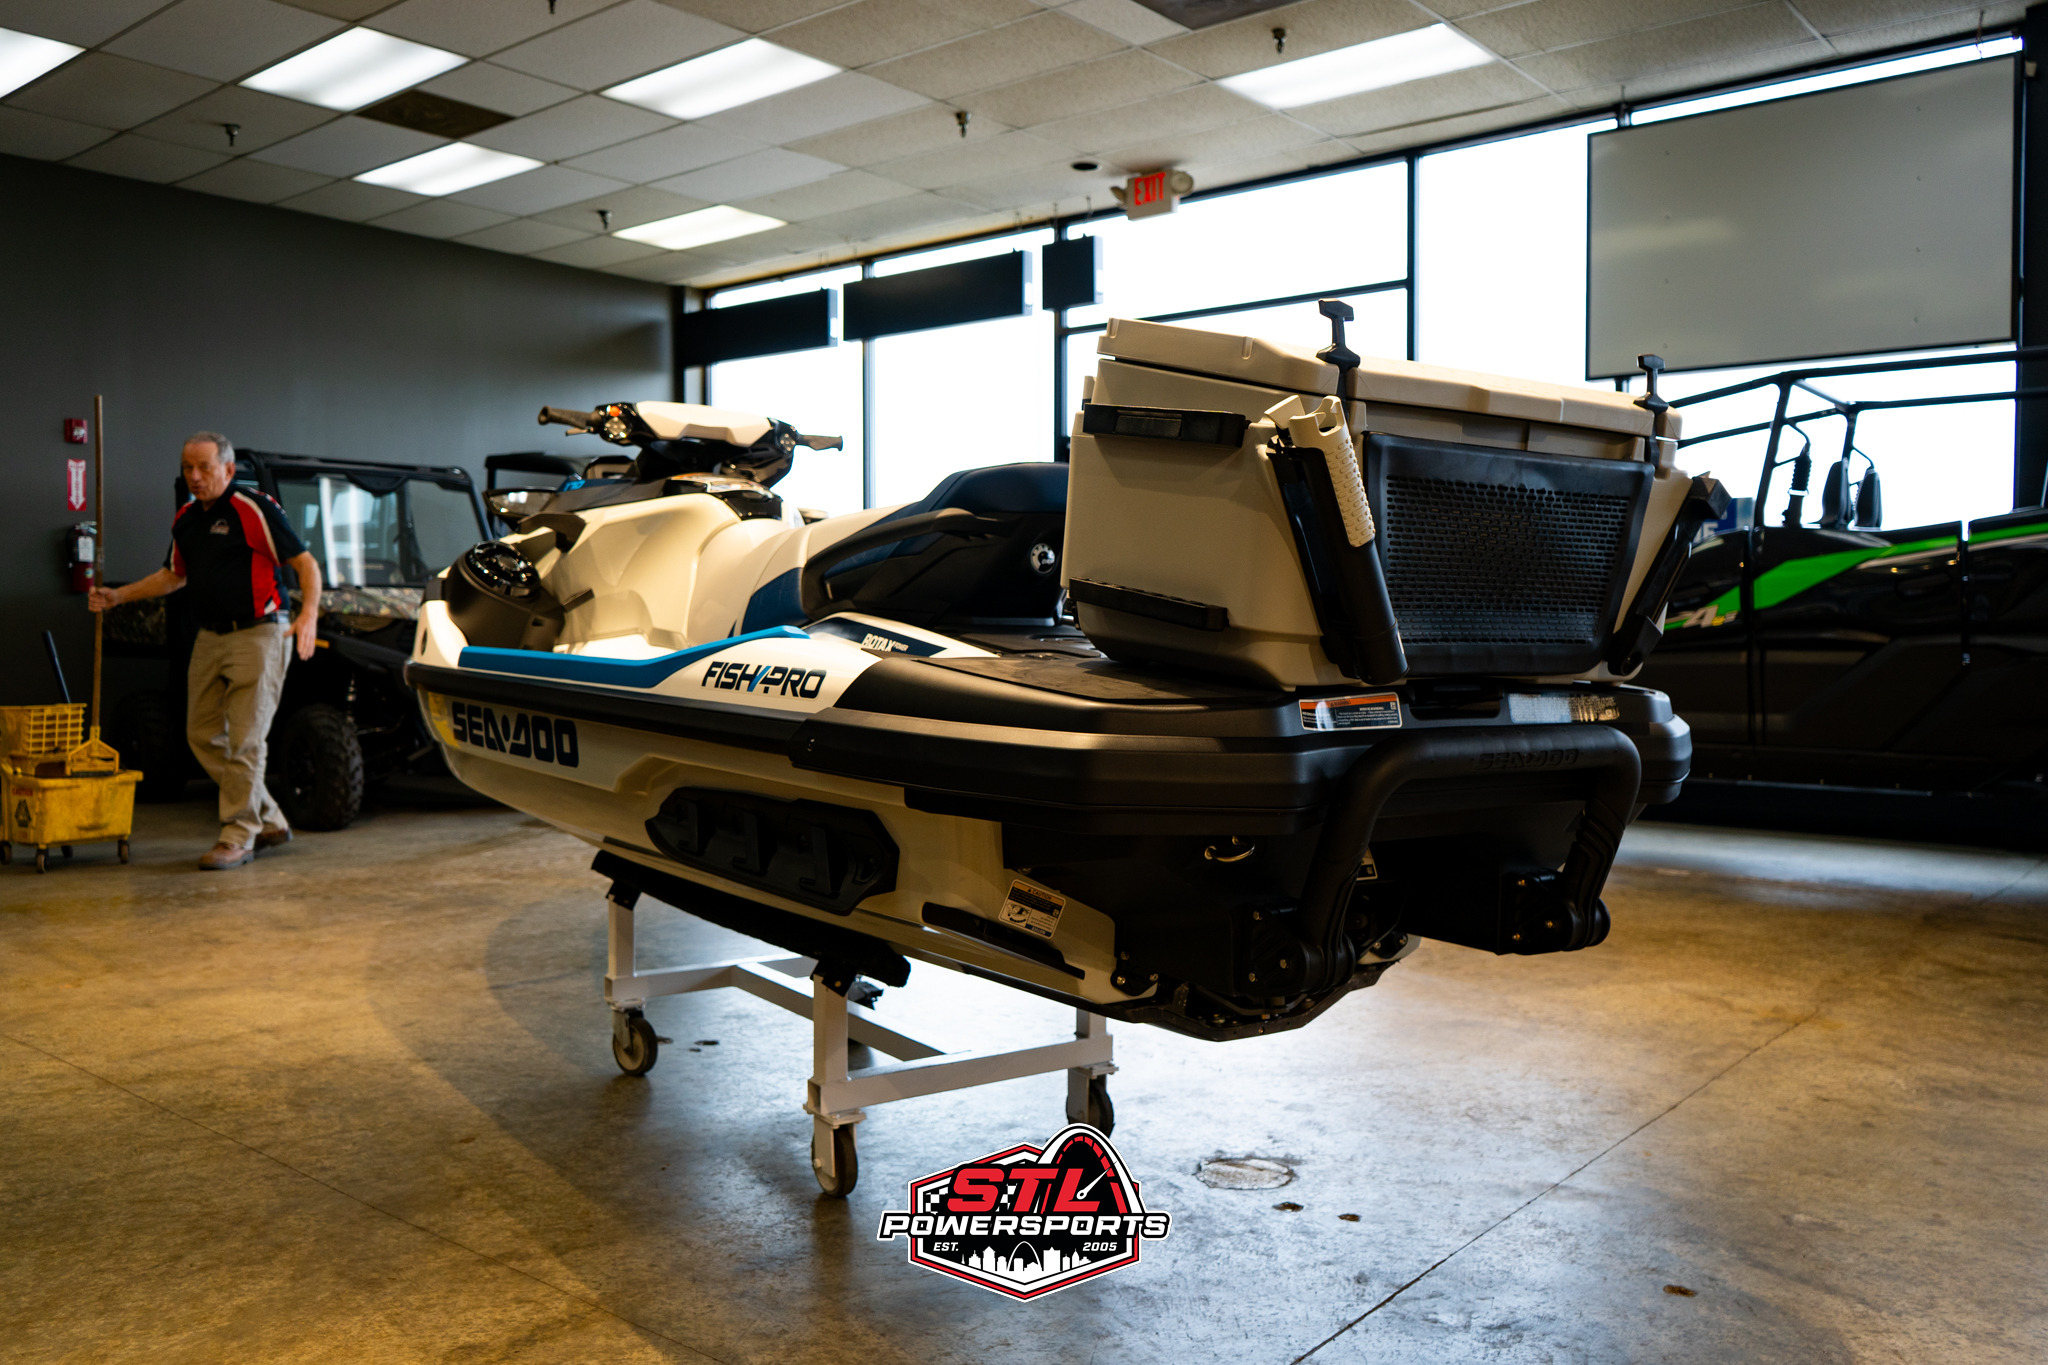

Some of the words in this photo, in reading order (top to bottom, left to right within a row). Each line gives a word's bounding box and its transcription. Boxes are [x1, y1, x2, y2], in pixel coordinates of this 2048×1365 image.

[1134, 172, 1166, 206] EXIT
[861, 632, 896, 652] ROTAX
[1032, 888, 1052, 901] CAUTION
